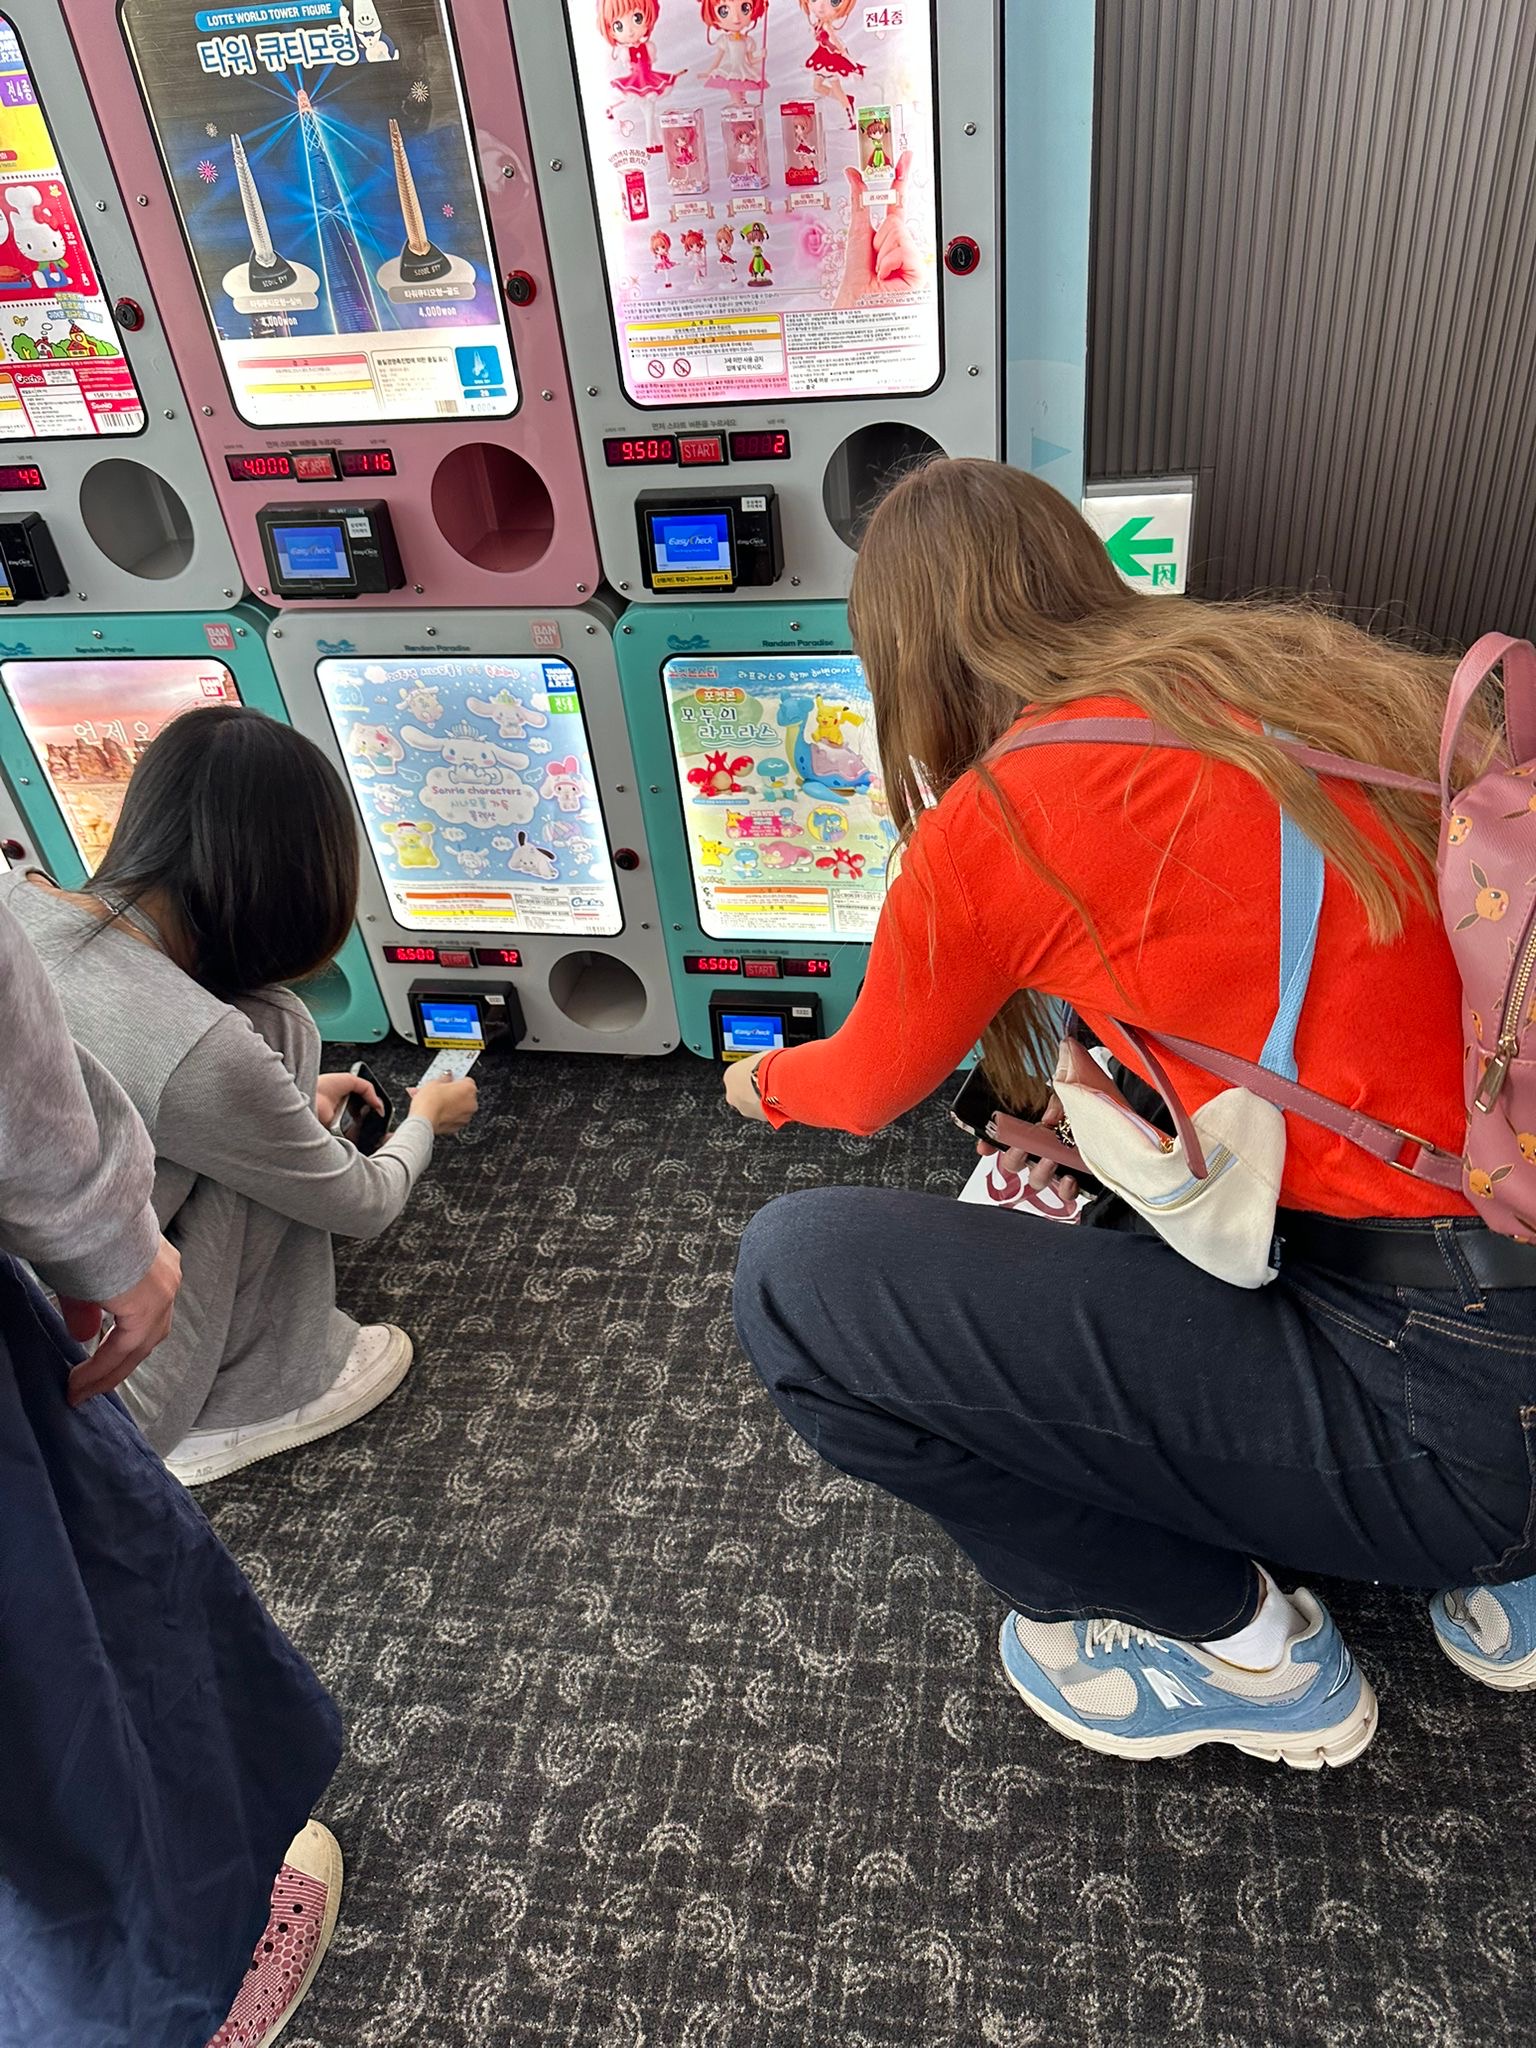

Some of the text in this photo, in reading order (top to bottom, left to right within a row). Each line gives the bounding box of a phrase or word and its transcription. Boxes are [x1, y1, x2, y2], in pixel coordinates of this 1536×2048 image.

[206, 4, 333, 27] LOTTE WORLD TOWER FIGURE
[198, 27, 358, 76] 타워 큐티모형
[15, 373, 45, 384] Gacha
[684, 442, 716, 459] START
[773, 435, 785, 453] 2
[298, 458, 329, 475] START
[362, 453, 392, 471] 116
[19, 468, 41, 486] 49
[668, 535, 714, 547] EasyCheck
[207, 627, 230, 637] BAN
[532, 625, 556, 636] BAN
[210, 636, 228, 646] DAI
[534, 635, 554, 645] DAI
[762, 638, 834, 647] Random Paradise
[703, 690, 737, 702] 포켓몬
[681, 707, 736, 724] 모두의
[73, 719, 129, 745] 언제
[699, 725, 777, 739] 라프라스
[432, 785, 521, 795] Sanrio characters
[500, 950, 518, 964] 72
[748, 964, 775, 977] START
[807, 960, 829, 973] 54
